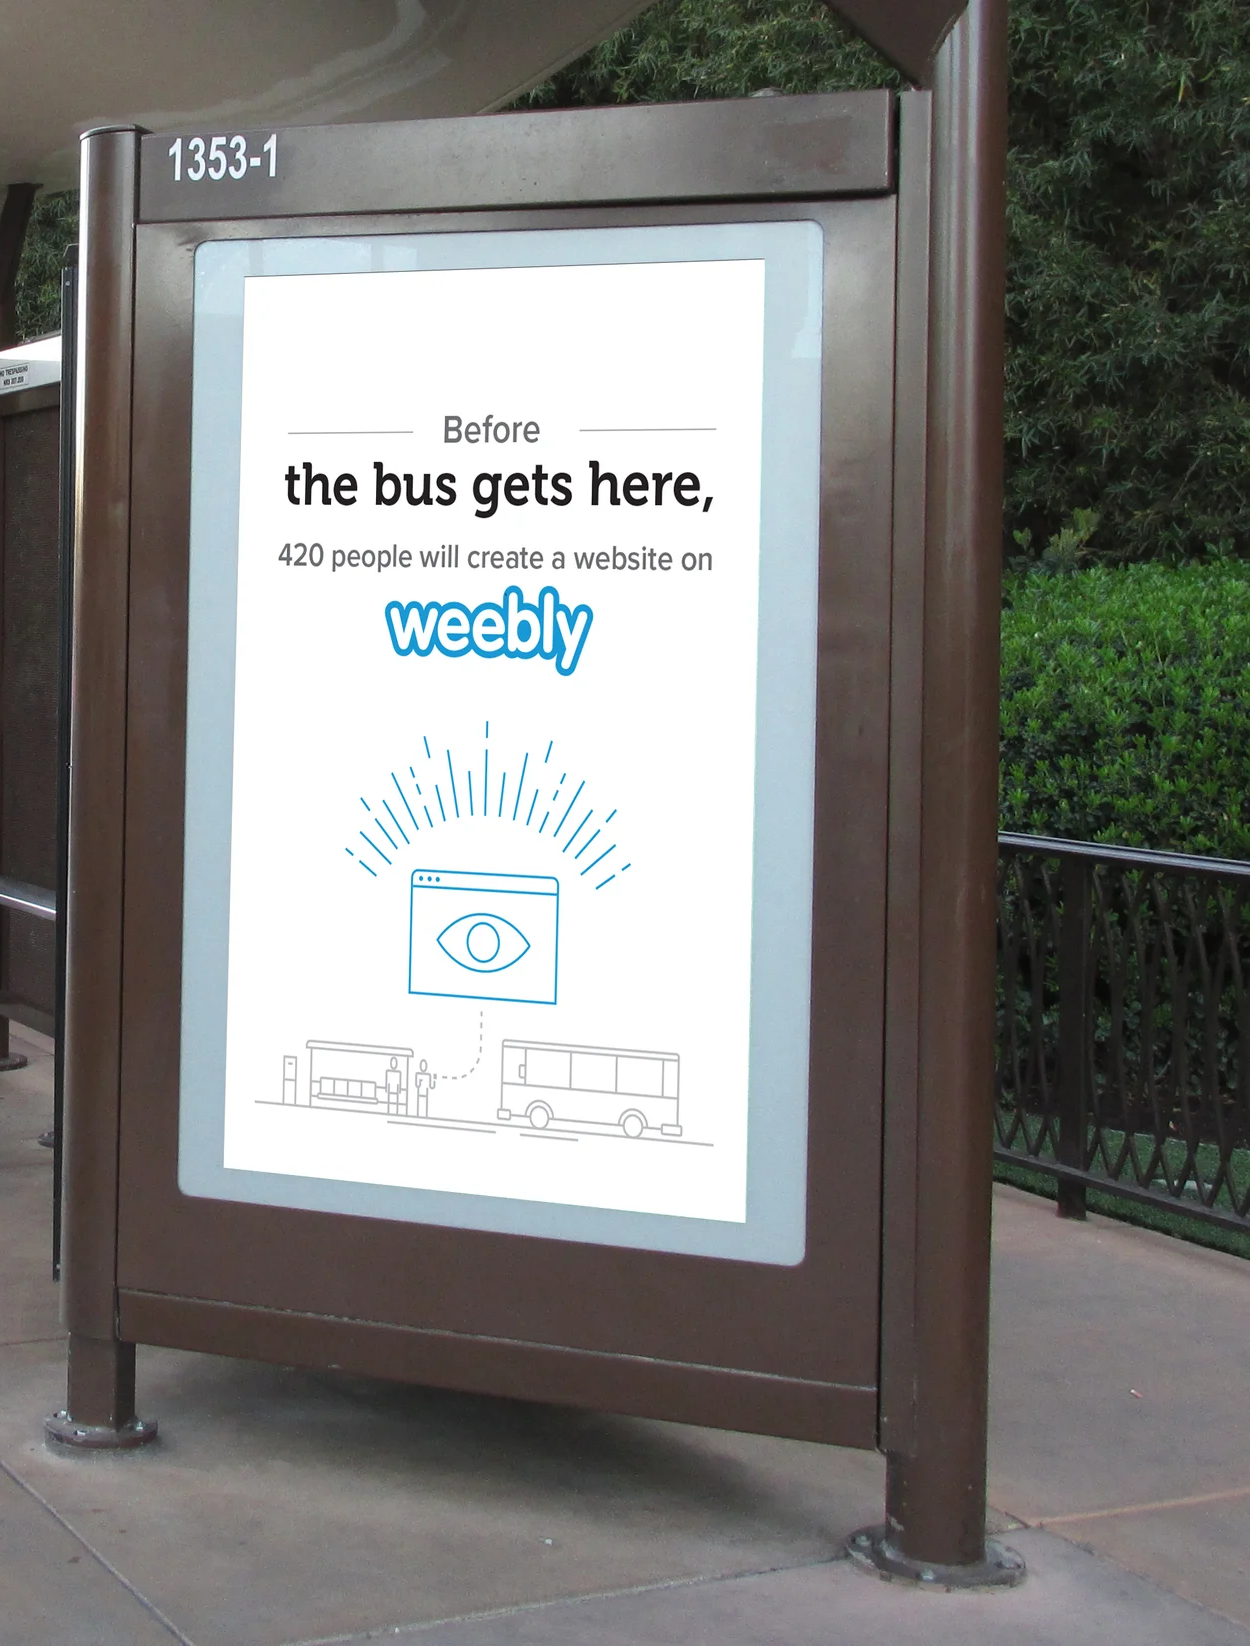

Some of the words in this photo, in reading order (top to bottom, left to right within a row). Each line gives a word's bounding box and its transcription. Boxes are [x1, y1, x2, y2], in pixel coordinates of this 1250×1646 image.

[168, 133, 278, 182] 1353-1
[443, 413, 541, 445] Before
[284, 461, 358, 507] the
[373, 461, 458, 507] bus
[472, 463, 573, 520] gets
[588, 460, 715, 513] here,
[277, 541, 325, 568] 420
[330, 543, 414, 573] people
[418, 544, 460, 569] will
[466, 546, 545, 571] create
[551, 549, 566, 571] a
[573, 545, 674, 572] website
[680, 551, 714, 573] on
[384, 584, 594, 677] weebly
